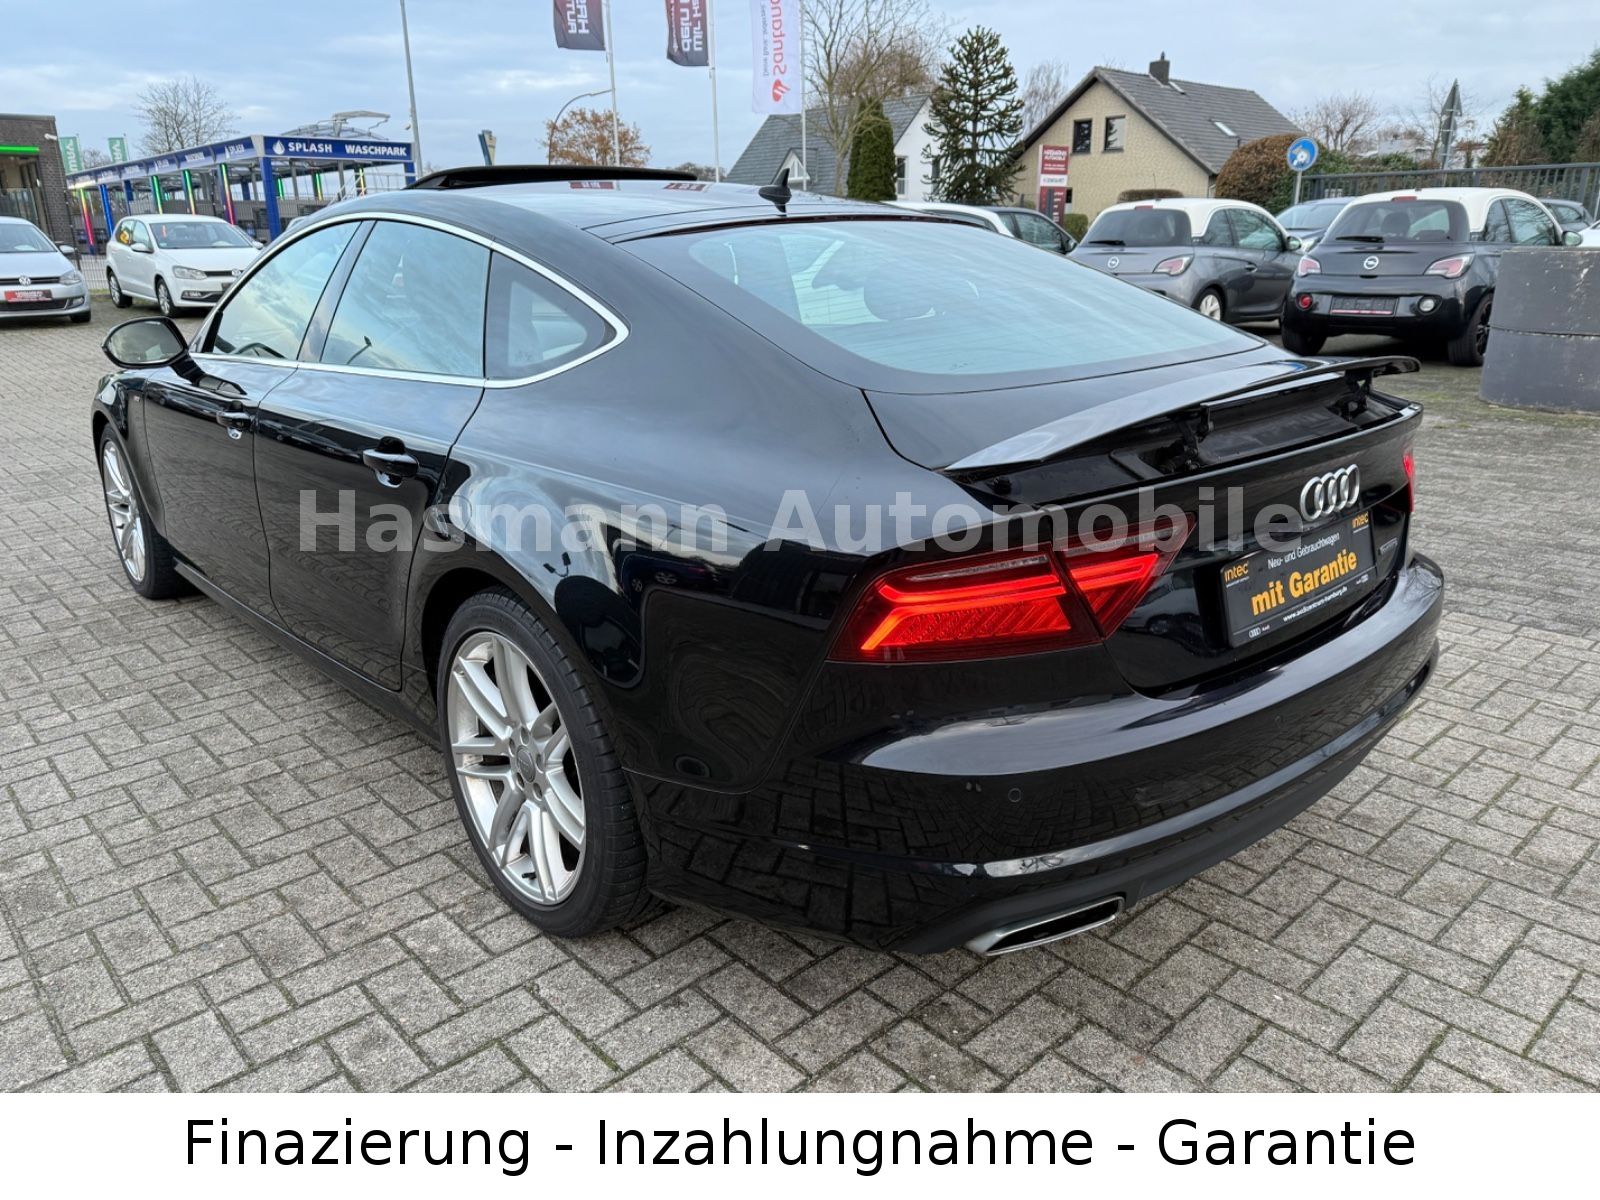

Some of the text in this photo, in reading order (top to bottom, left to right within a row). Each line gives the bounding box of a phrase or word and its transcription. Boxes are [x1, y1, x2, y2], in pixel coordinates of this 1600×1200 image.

[288, 142, 407, 156] SPLASH WASCHPARK
[1267, 532, 1340, 570] Neu- und Gebrauchtwagen
[1251, 549, 1357, 616] mit Garantie
